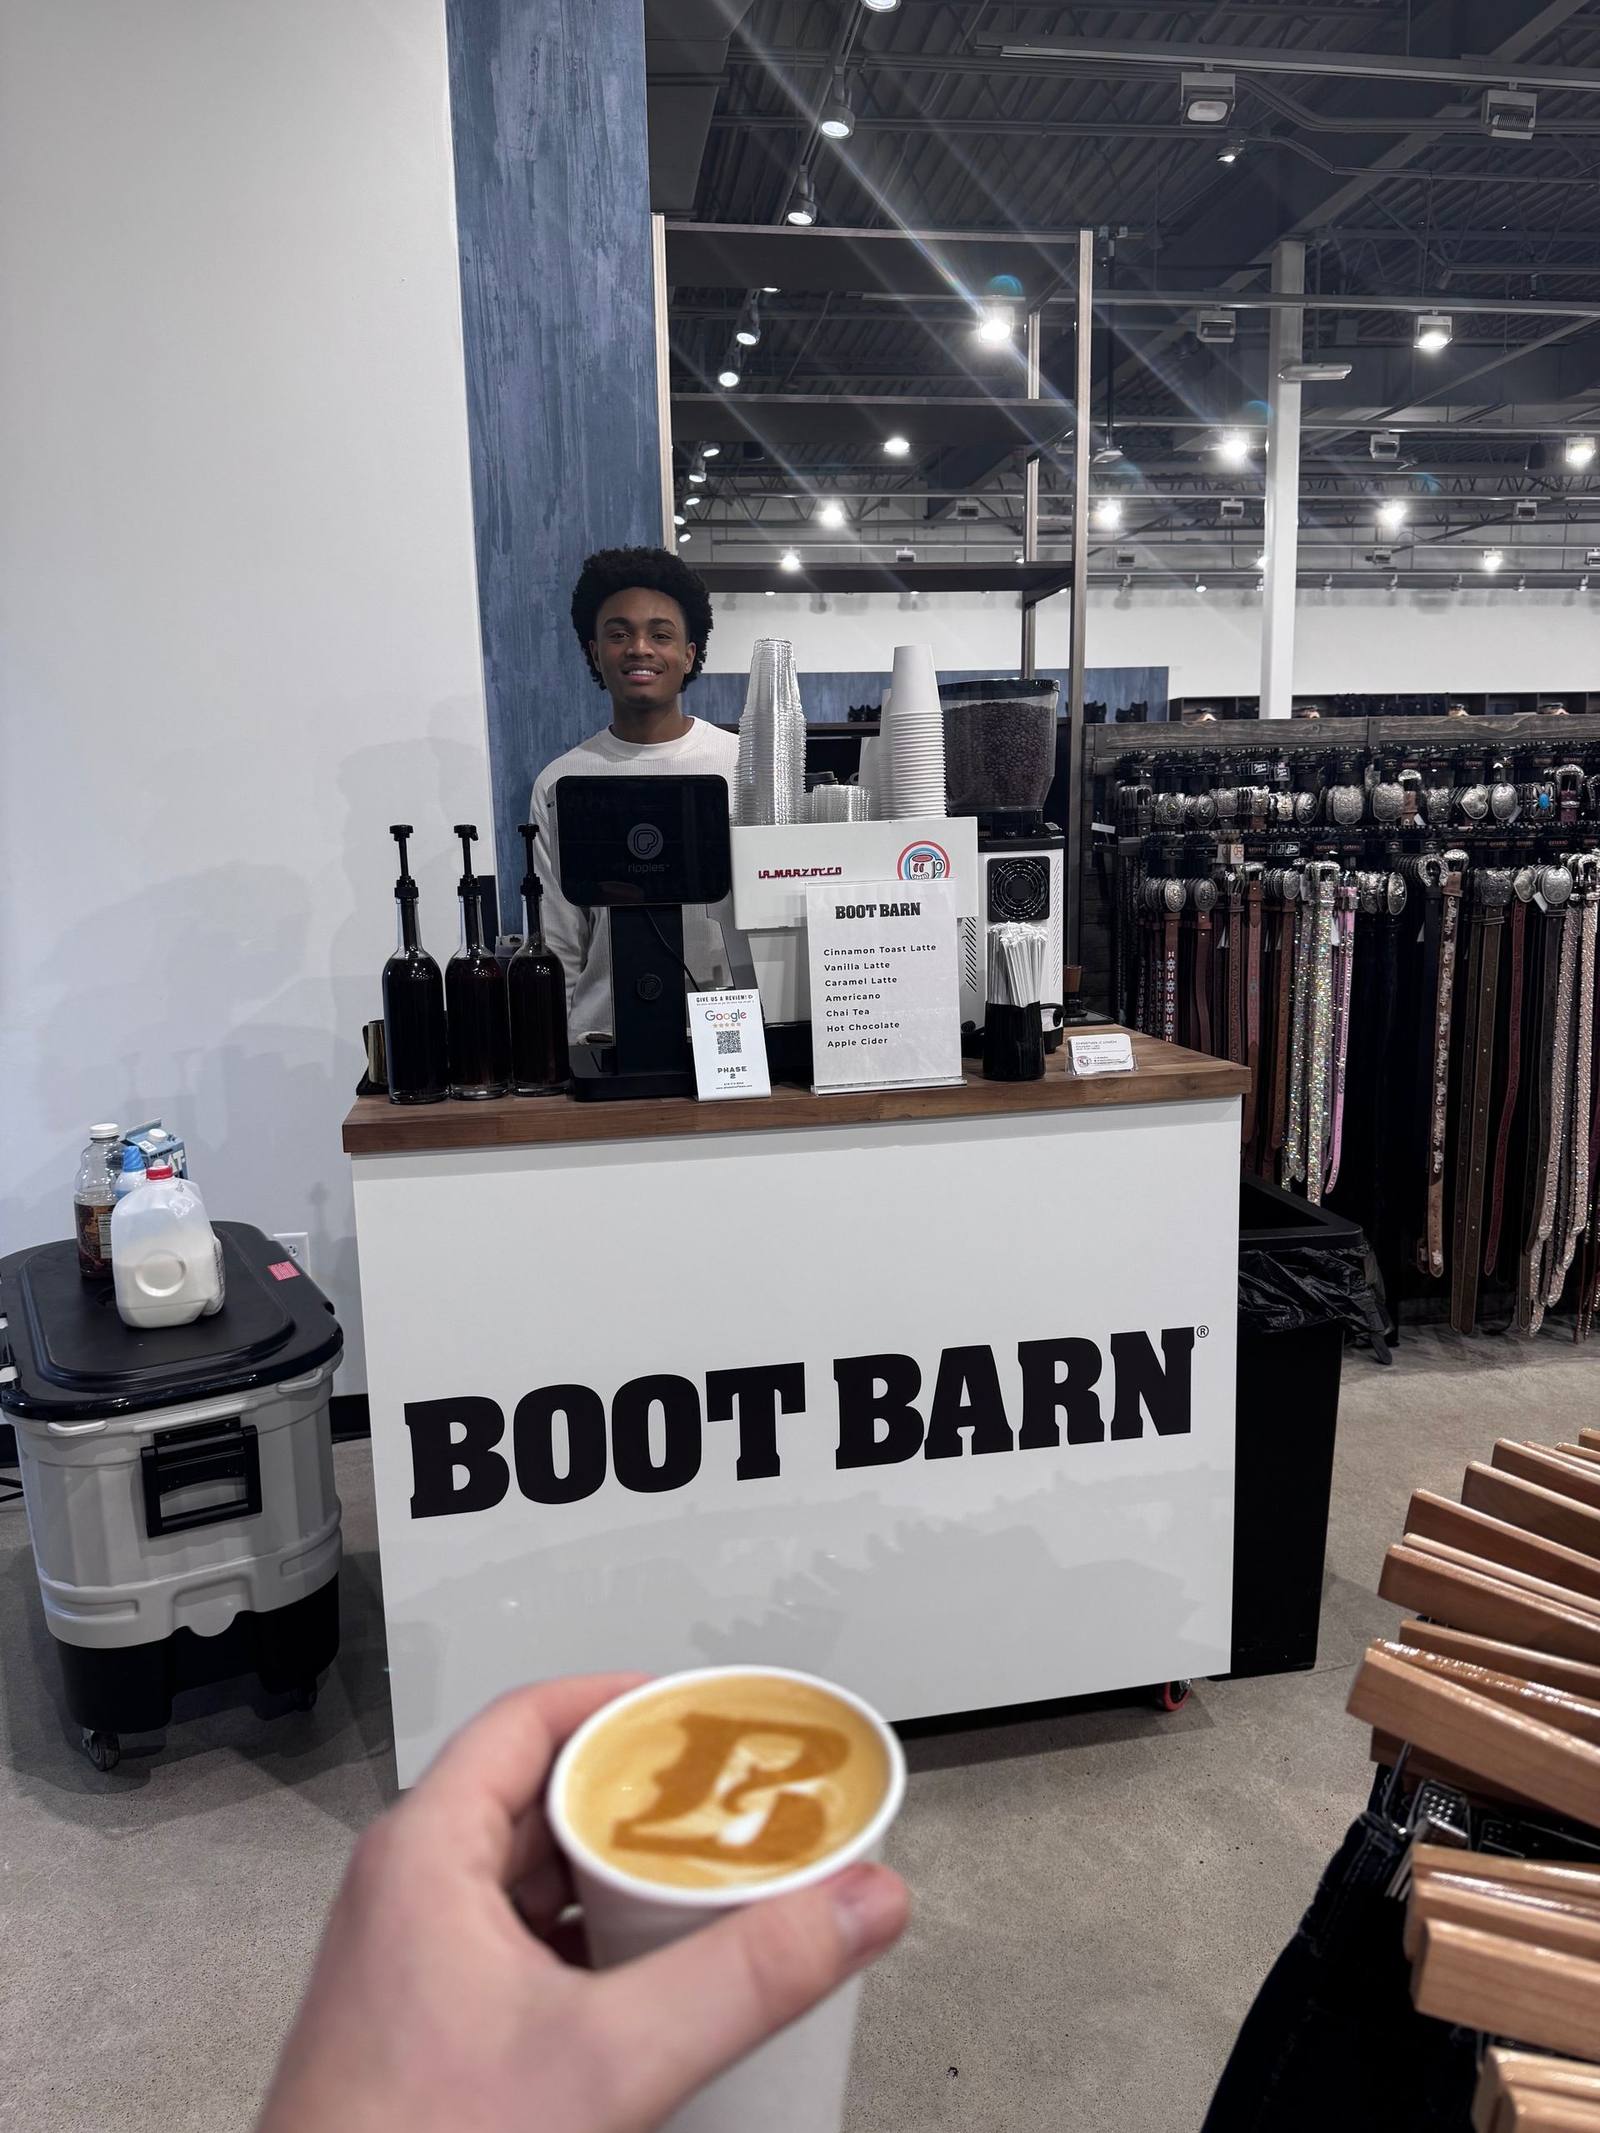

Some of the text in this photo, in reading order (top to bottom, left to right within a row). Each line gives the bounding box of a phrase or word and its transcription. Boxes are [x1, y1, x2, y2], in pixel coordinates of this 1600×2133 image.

[835, 902, 921, 919] BOOT BARN
[823, 948, 875, 956] Cinnamon
[910, 944, 936, 952] Latte
[824, 962, 890, 971] Vanilla Latte
[825, 978, 867, 987] Caramel
[825, 993, 881, 1002] Americano
[705, 1008, 747, 1022] Google
[826, 1008, 870, 1017] Chai Tea
[849, 1022, 900, 1031] Chocolate
[827, 1040, 857, 1048] Apple
[717, 1065, 748, 1074] PHASE
[403, 1361, 807, 1520] BOOT
